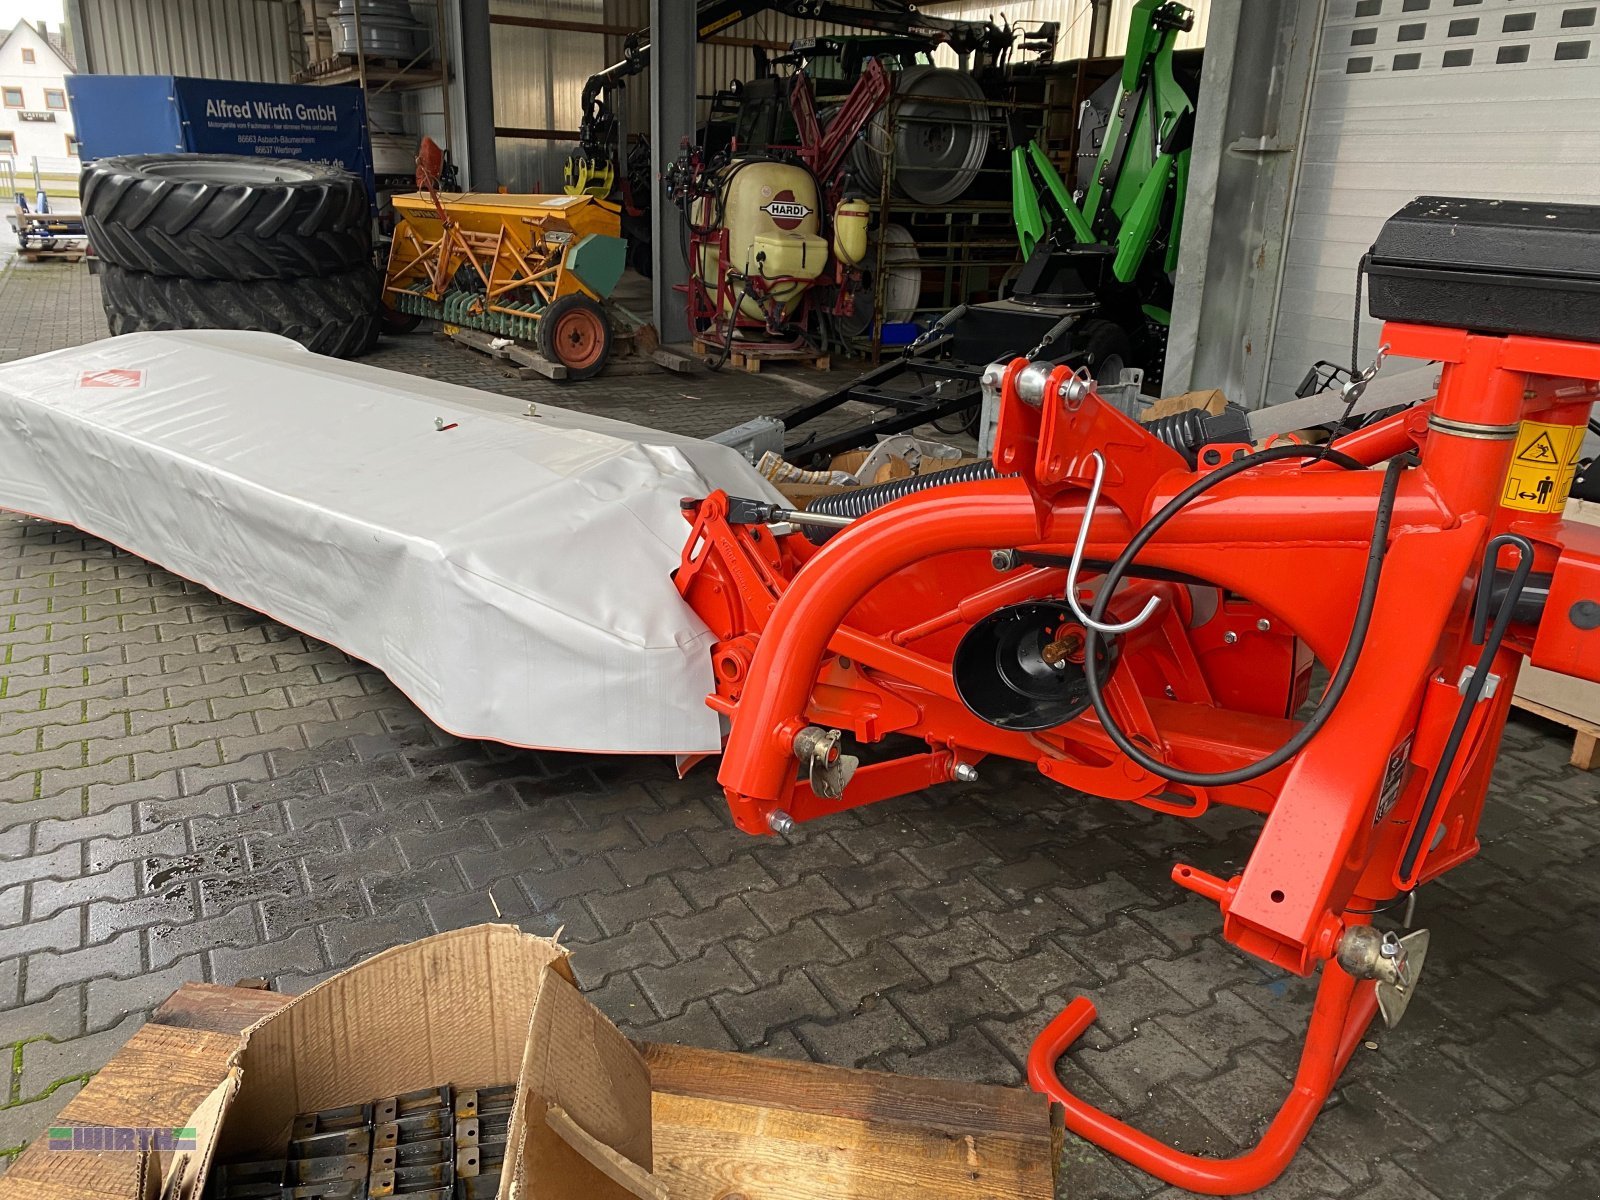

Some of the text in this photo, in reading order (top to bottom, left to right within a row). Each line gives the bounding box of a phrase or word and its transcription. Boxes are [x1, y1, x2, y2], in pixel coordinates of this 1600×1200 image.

[206, 99, 337, 121] Alfred Wirth GmbH
[237, 134, 256, 143] 86663
[772, 205, 803, 215] HARDI
